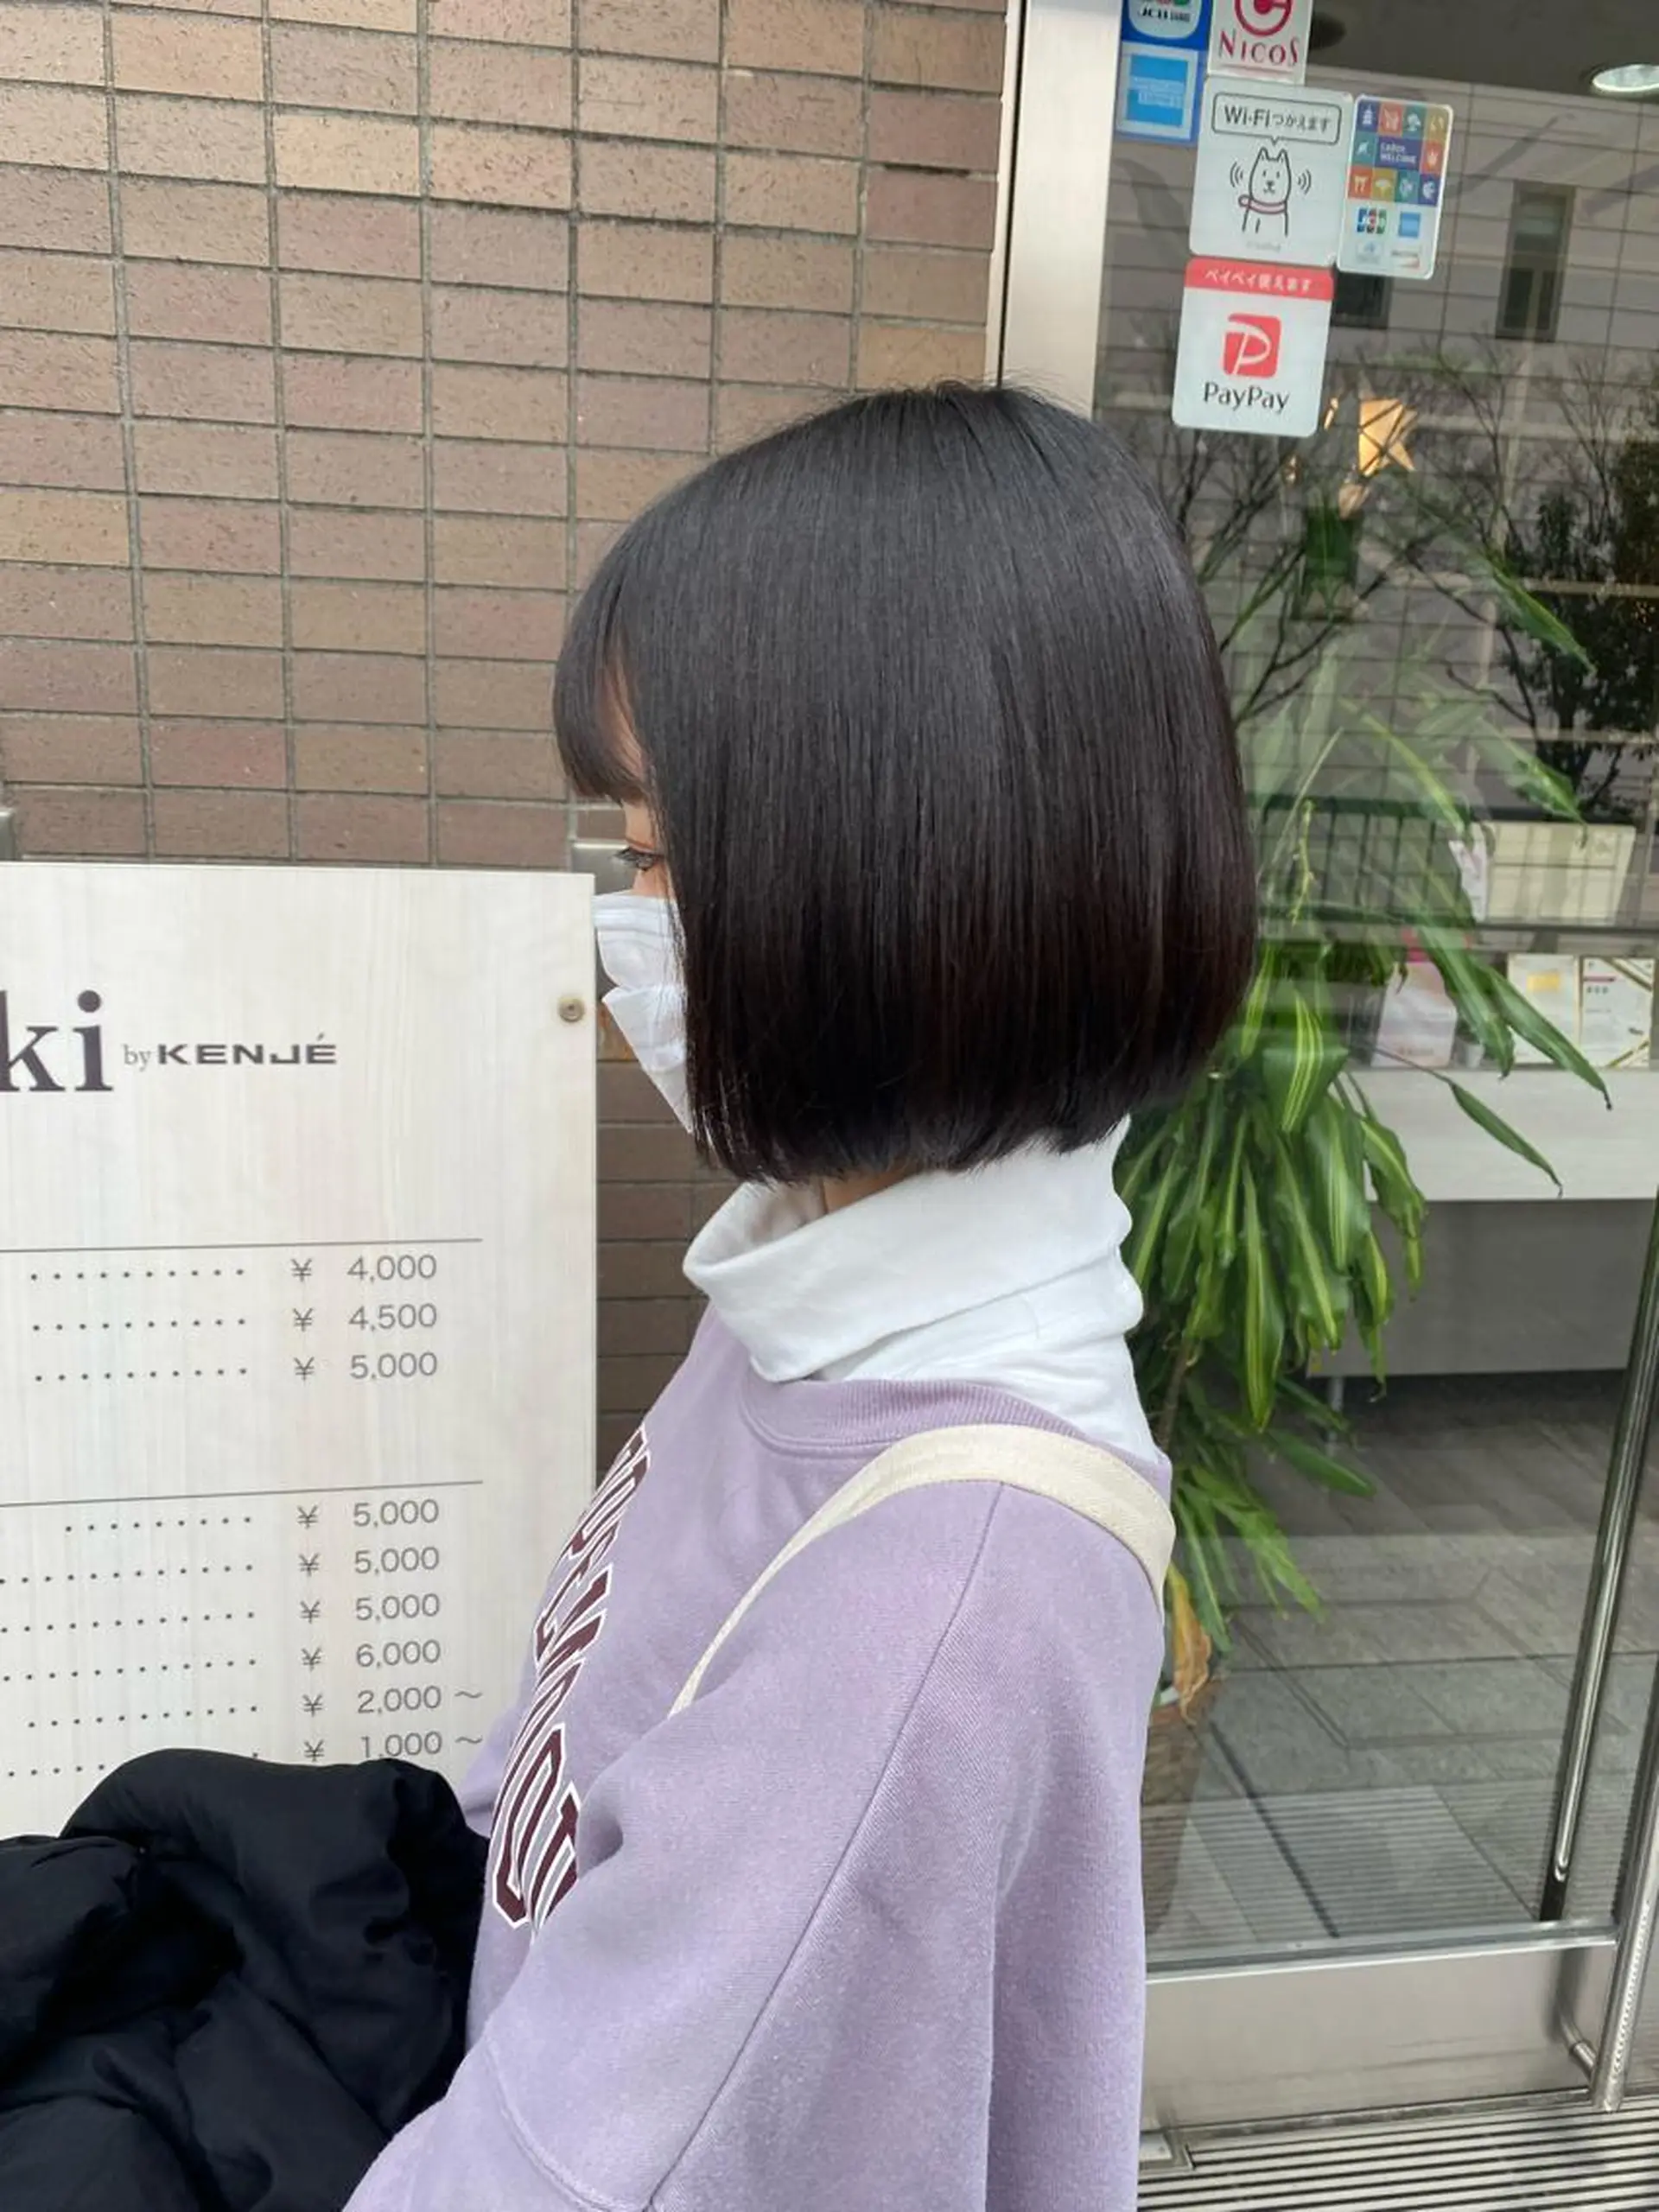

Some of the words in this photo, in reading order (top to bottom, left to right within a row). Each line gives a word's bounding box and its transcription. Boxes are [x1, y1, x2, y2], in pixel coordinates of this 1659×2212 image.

[1217, 28, 1300, 67] NICOS
[1203, 381, 1290, 415] PayPay
[123, 1043, 154, 1071] by
[157, 1033, 338, 1065] KENJÉ
[346, 1253, 437, 1284] 4,000
[347, 1302, 438, 1332] 4,500
[349, 1351, 439, 1381] 5,000
[353, 1498, 440, 1529] 5,000
[353, 1545, 441, 1576] 5,000
[355, 1592, 442, 1623] 5,000
[355, 1638, 442, 1669] 6,000
[357, 1684, 443, 1714] 2,000
[360, 1731, 443, 1760] 1,000
